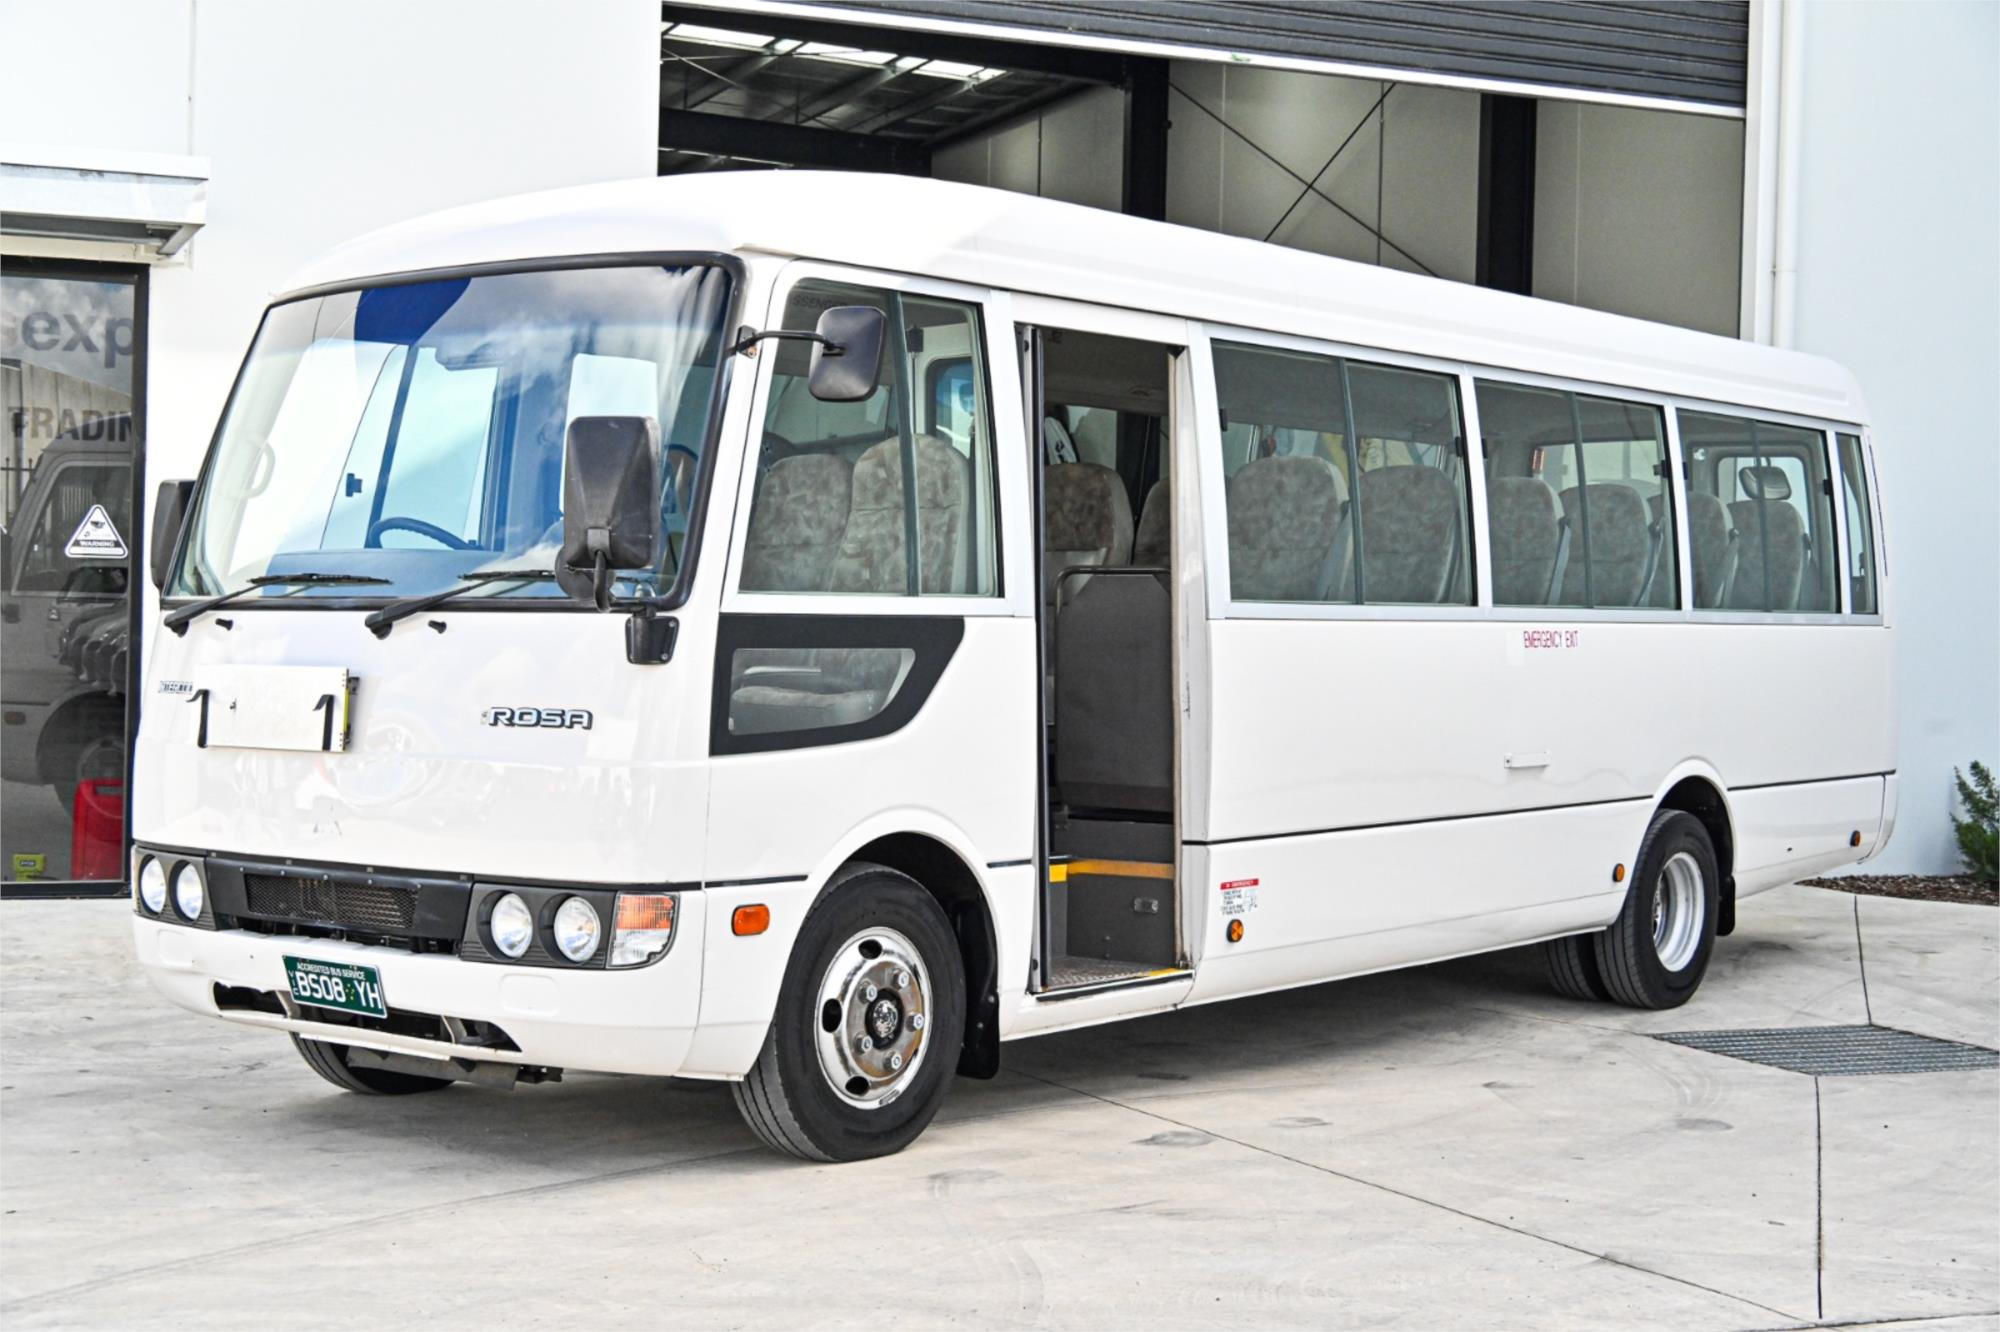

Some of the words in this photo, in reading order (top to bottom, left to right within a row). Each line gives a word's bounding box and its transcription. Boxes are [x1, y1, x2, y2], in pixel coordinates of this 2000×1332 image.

[1523, 630, 1562, 648] EMERGENCY
[1565, 630, 1578, 648] EXIT
[488, 706, 593, 730] ROSA
[297, 962, 330, 975] ACCREDITED
[330, 966, 341, 977] BUS
[342, 969, 366, 981] SERVICE
[295, 971, 347, 1003] BS08
[353, 979, 382, 1009] YH
